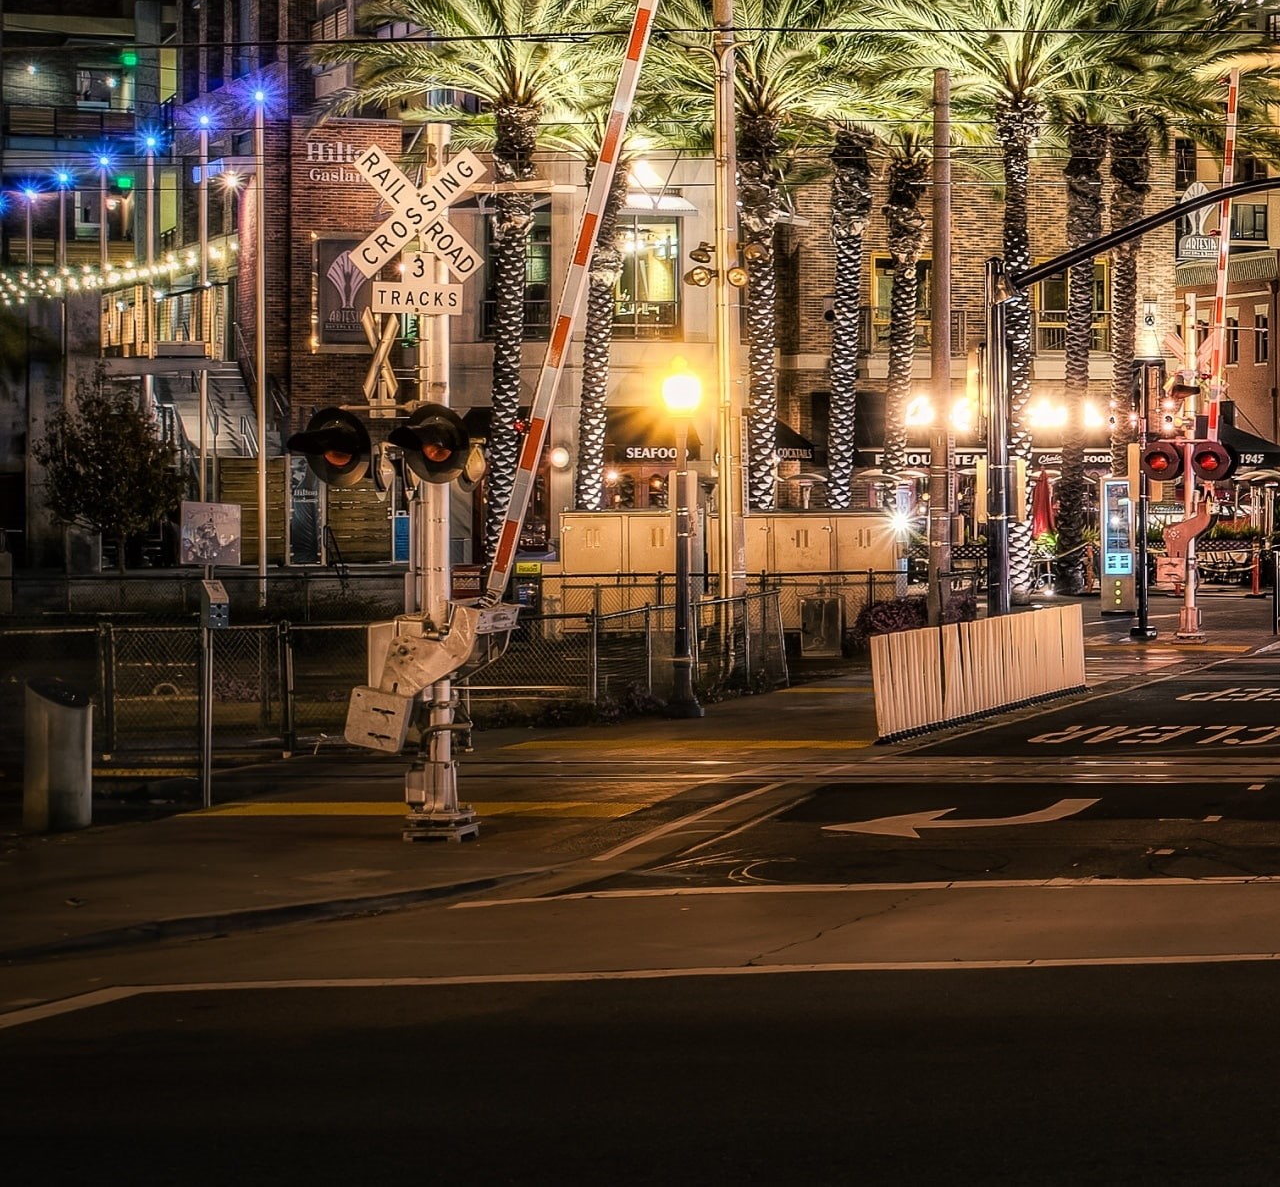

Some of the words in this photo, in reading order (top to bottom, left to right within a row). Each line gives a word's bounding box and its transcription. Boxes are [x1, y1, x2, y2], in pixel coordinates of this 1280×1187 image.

[306, 142, 366, 162] Hilto
[361, 152, 405, 204] RAIL
[425, 221, 475, 272] ROAD
[362, 161, 474, 264] CROSSING
[1185, 237, 1218, 250] ARTESIA
[412, 258, 425, 278] 3
[378, 290, 457, 306] TRACKS
[777, 447, 813, 459] COCKTAILS
[1240, 453, 1264, 464] 1945
